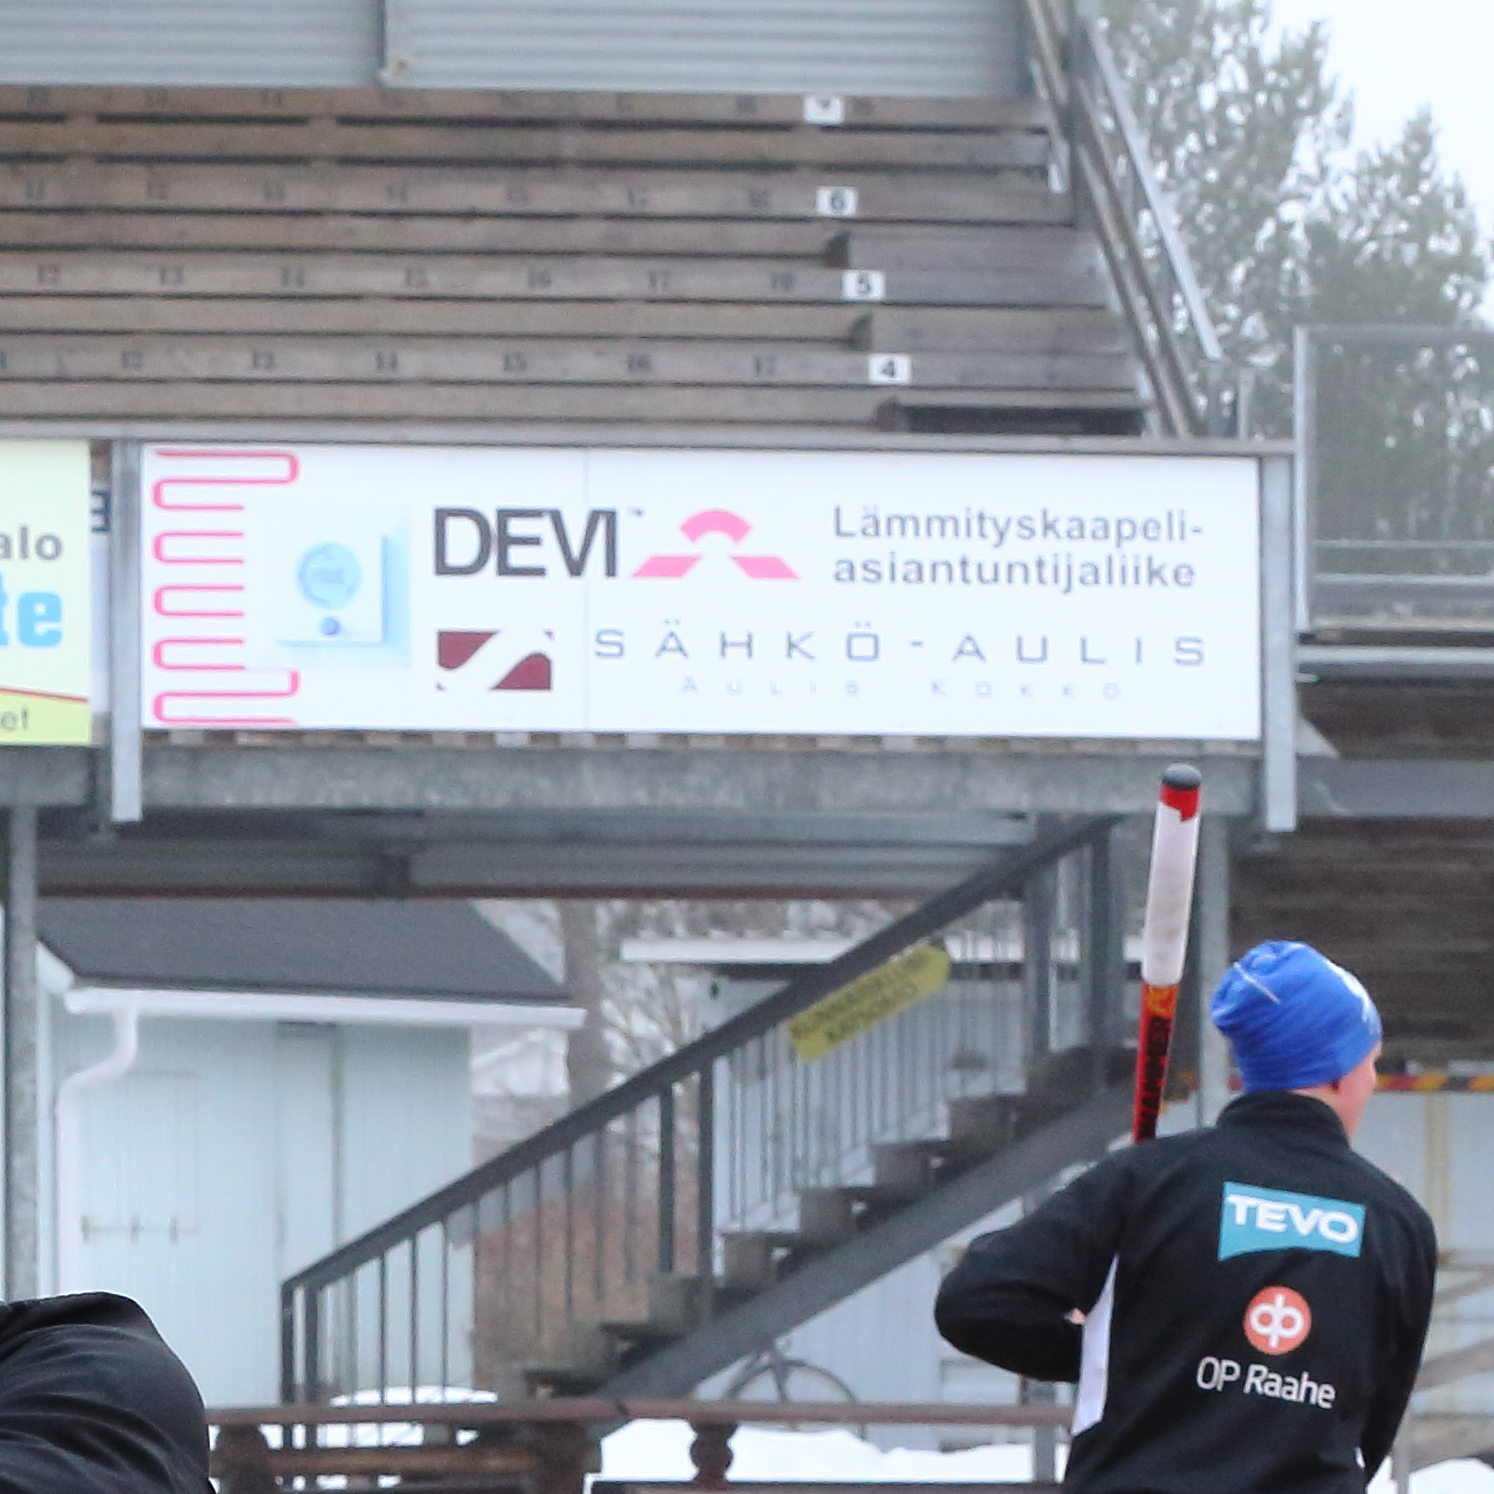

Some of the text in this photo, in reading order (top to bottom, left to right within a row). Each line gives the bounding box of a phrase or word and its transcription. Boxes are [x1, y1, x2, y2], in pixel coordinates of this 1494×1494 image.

[830, 187, 846, 211] 6
[857, 271, 871, 294] 5
[880, 356, 897, 379] 4
[433, 507, 618, 579] DEVI
[833, 504, 1204, 547] Lämmityskaapeli-
[834, 551, 1197, 595] asiantuntijaliike
[1226, 1193, 1359, 1244] TEVO
[1196, 1356, 1336, 1410] OP Raahe
